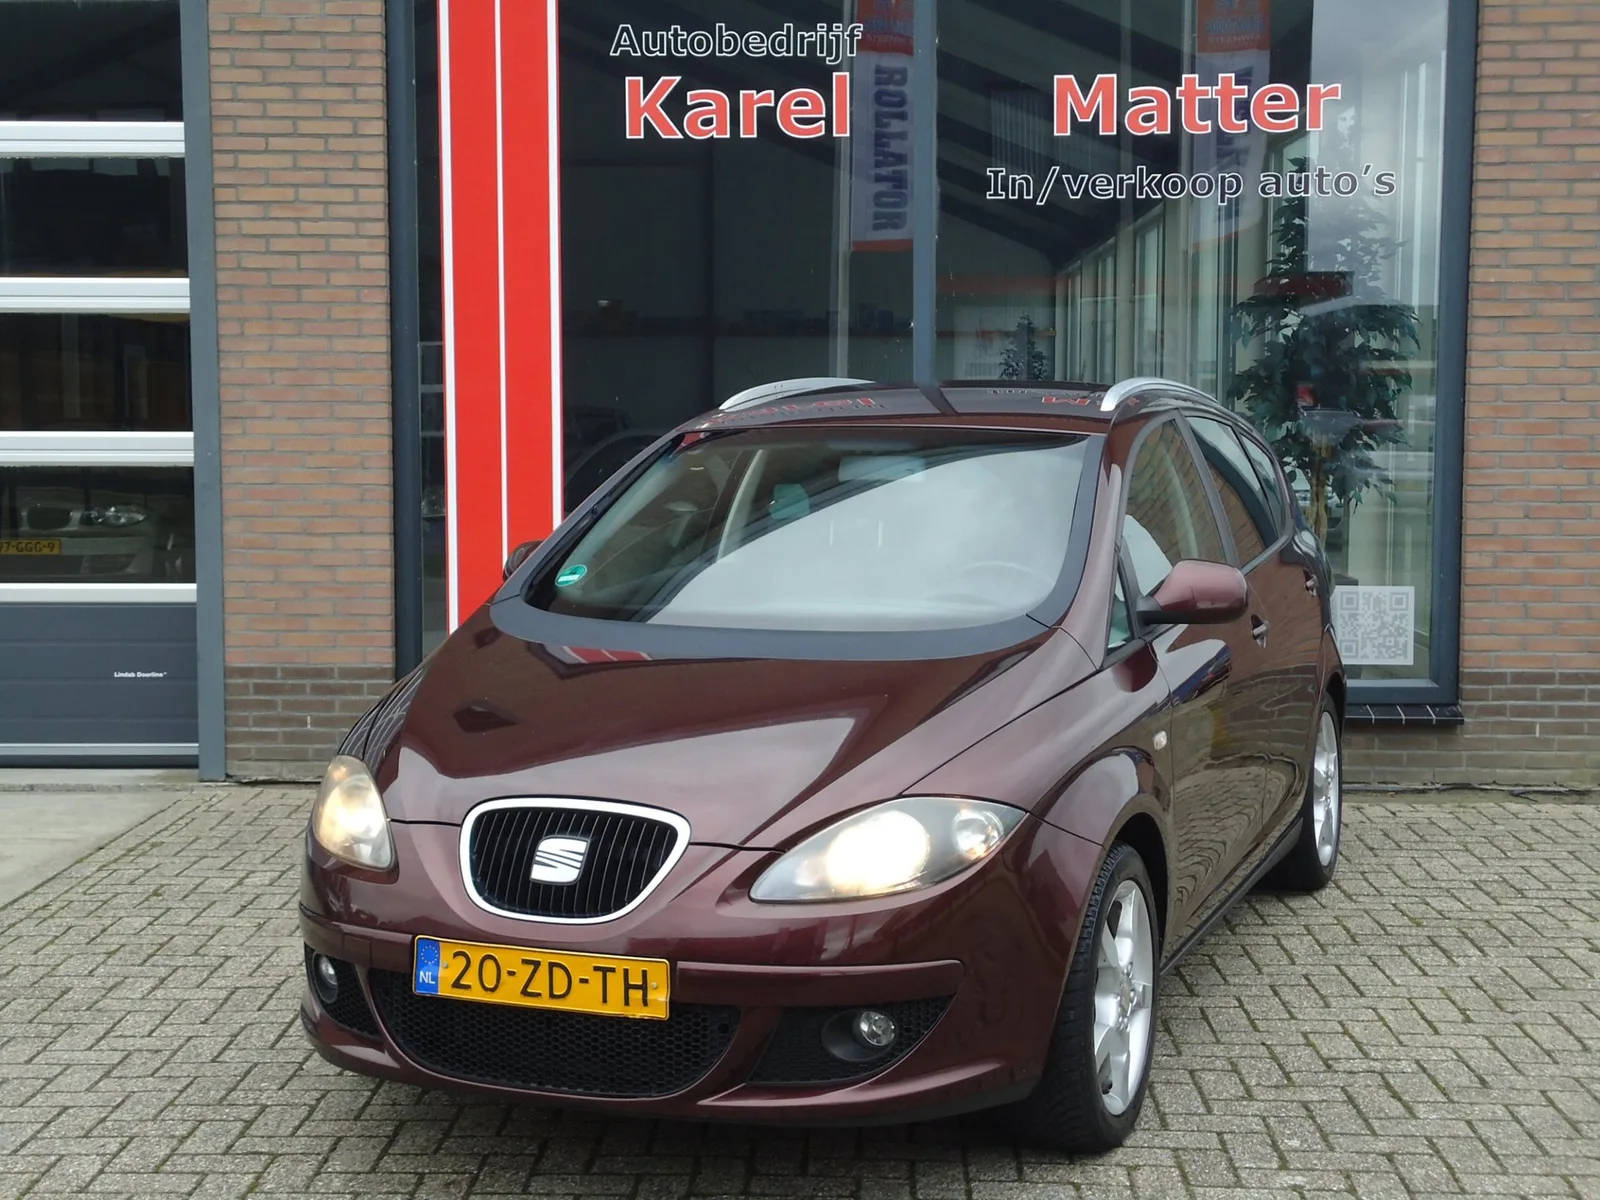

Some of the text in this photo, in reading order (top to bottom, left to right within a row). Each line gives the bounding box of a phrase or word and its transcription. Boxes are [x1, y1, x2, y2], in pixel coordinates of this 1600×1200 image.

[610, 24, 863, 64] Autobedrijf
[625, 72, 1342, 140] Karel Matter
[871, 64, 908, 232] ROLLATOR
[986, 164, 1396, 205] In/verkoop auto's
[419, 950, 649, 1007] NL 20-ZD-TH
